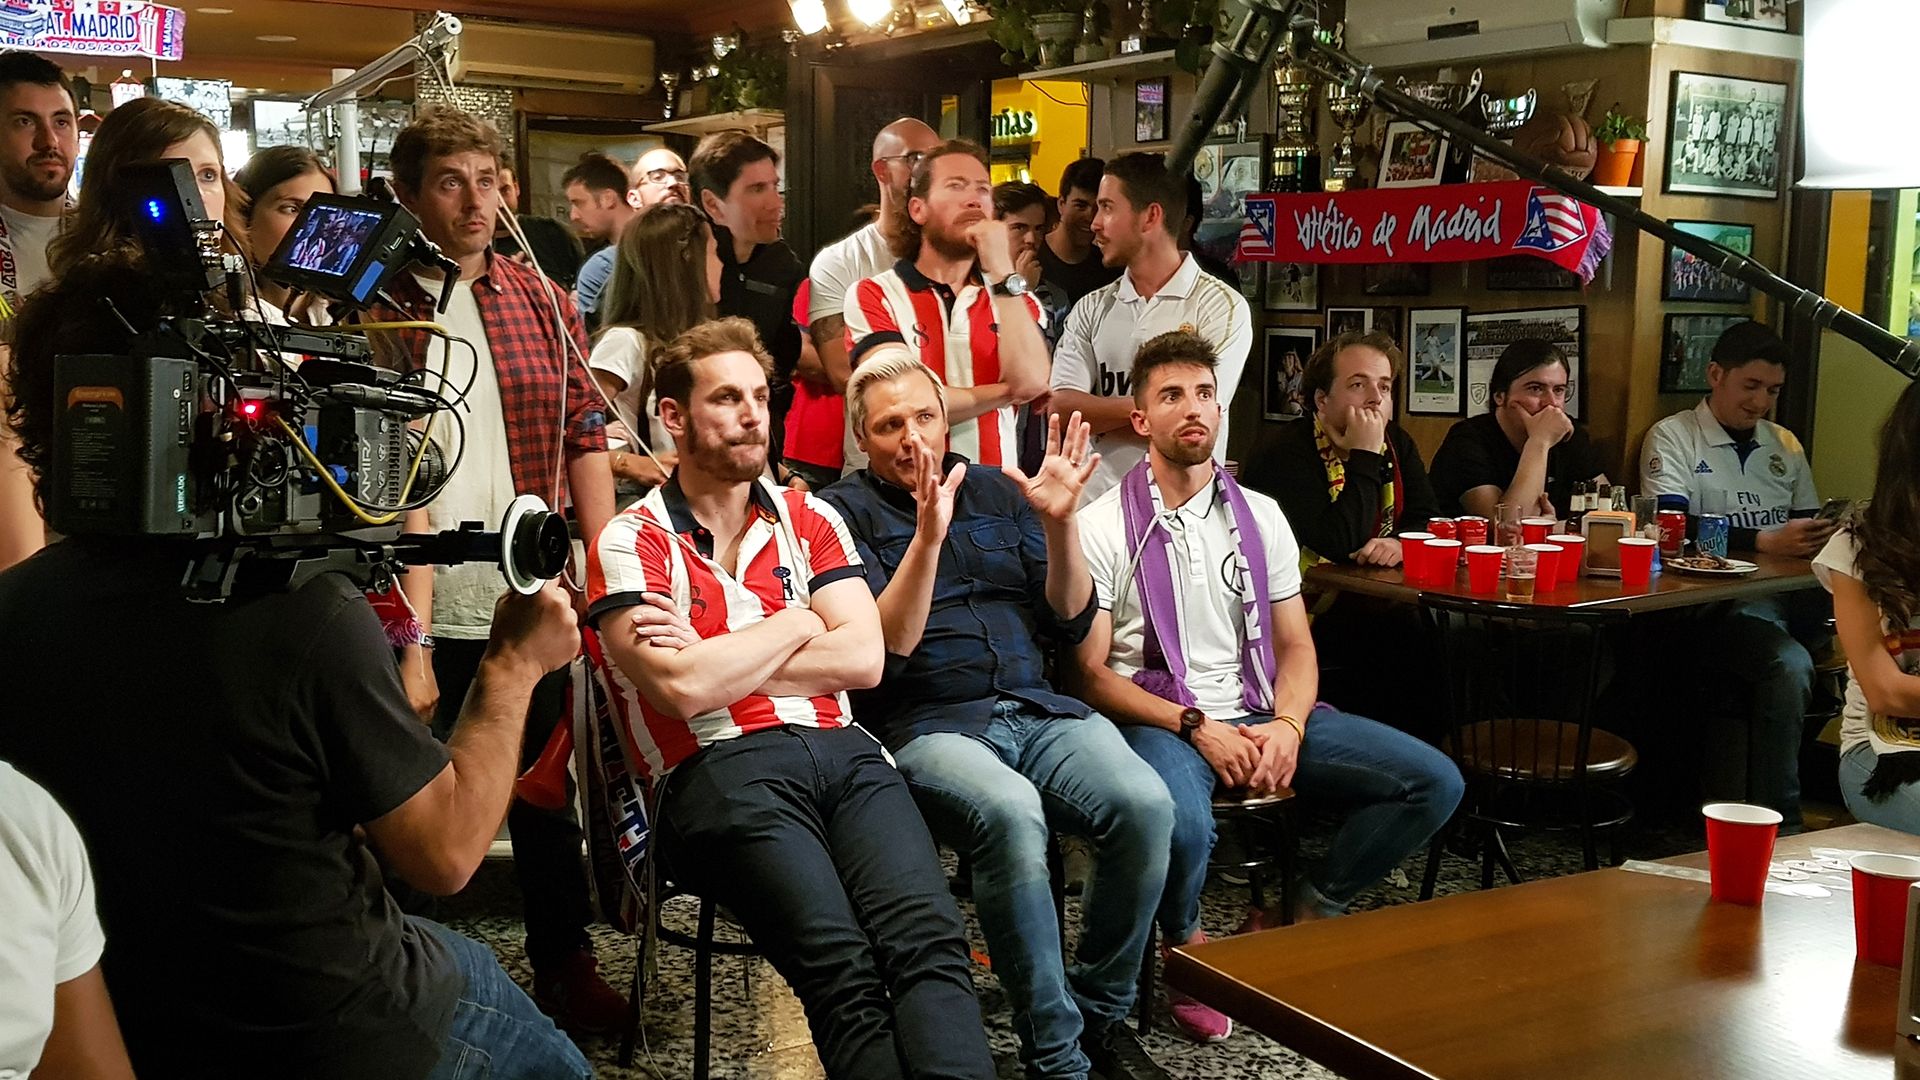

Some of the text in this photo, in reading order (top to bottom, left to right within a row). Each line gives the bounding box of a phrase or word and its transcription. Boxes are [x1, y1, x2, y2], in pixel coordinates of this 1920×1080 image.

[46, 10, 137, 39] AT. MADRID
[163, 9, 175, 44] MADRID
[50, 40, 139, 51] 02/05/2017
[1294, 196, 1501, 257] Atlético de Madrid
[912, 323, 930, 349] 8
[1737, 491, 1761, 507] Fly
